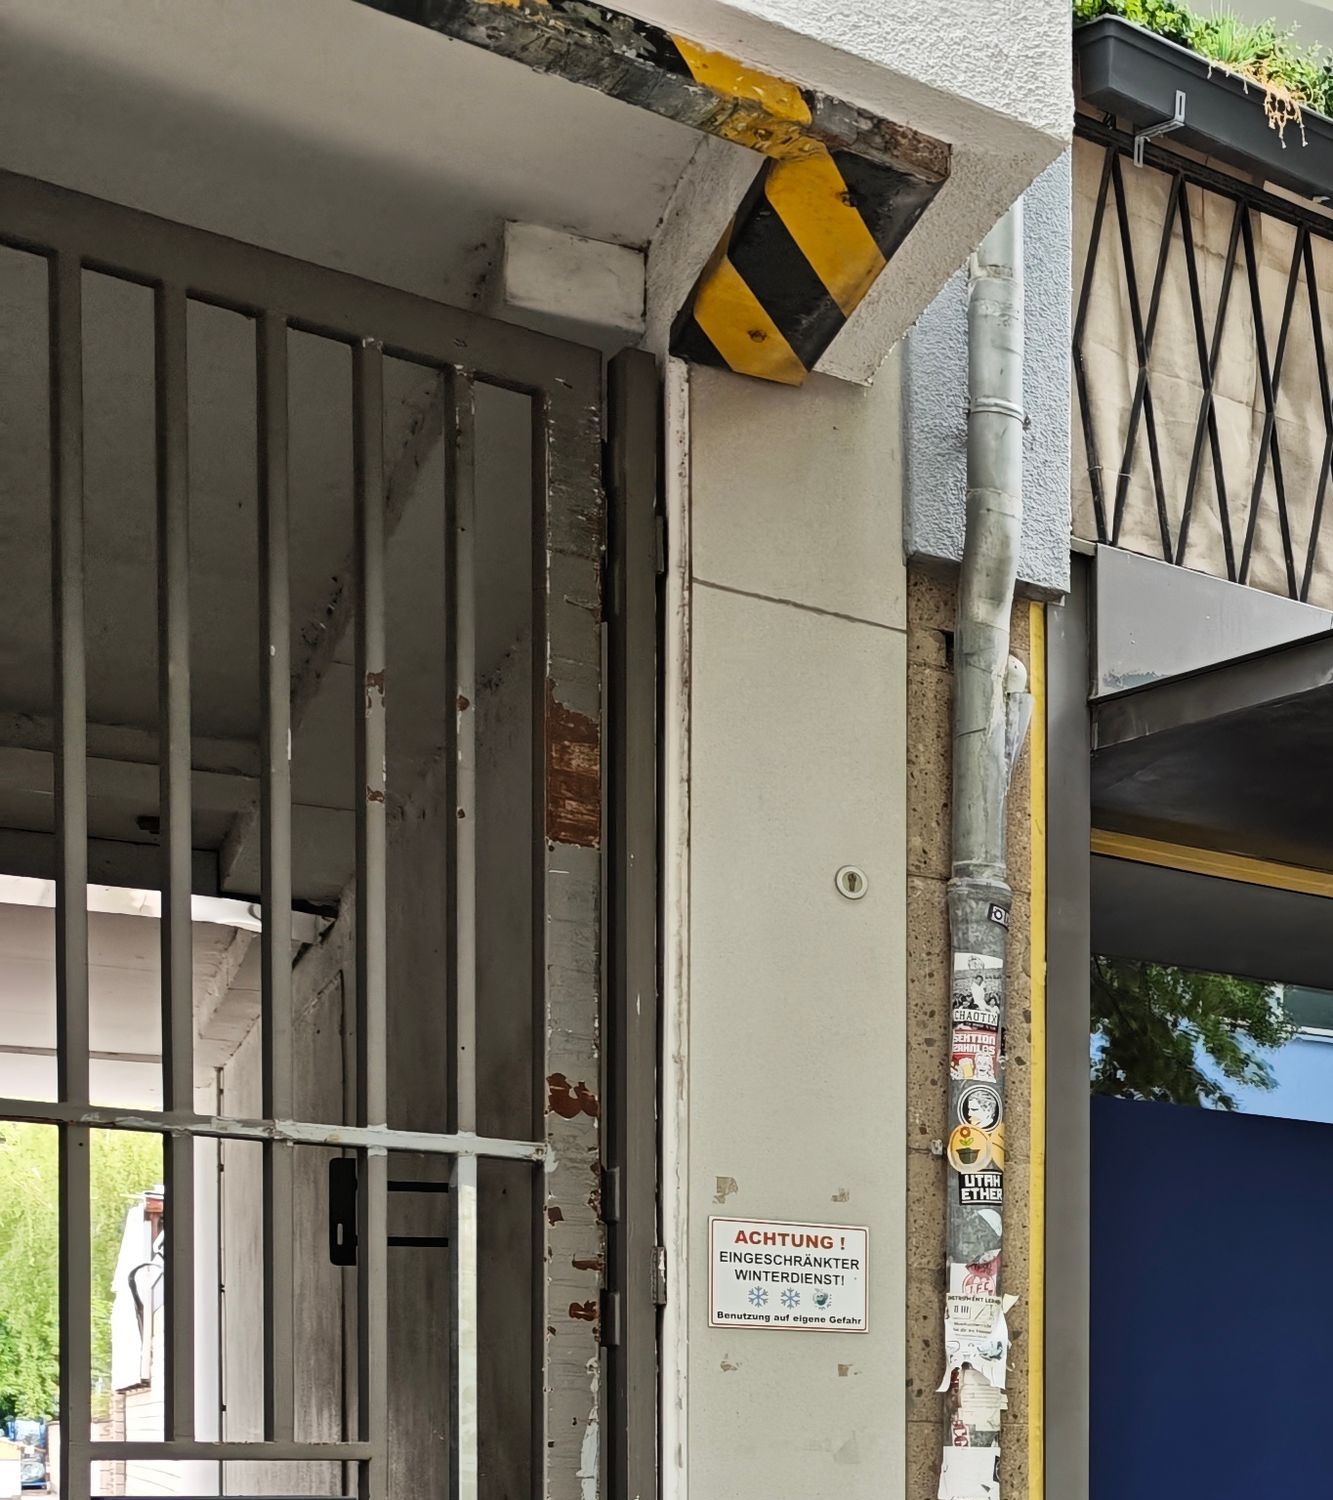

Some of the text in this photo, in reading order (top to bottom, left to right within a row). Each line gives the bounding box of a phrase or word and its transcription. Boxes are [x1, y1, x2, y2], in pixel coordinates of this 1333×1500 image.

[955, 1010, 997, 1026] CHAOTIX
[965, 1175, 1000, 1187] UTAH
[961, 1188, 1002, 1200] ETHER
[735, 1230, 834, 1250] ACHTUNG
[719, 1251, 860, 1270] EINGESCHRÄNKTER
[734, 1269, 845, 1286] WINTERDIENST!
[717, 1311, 862, 1325] Benutzung auf eigene Gefahr
